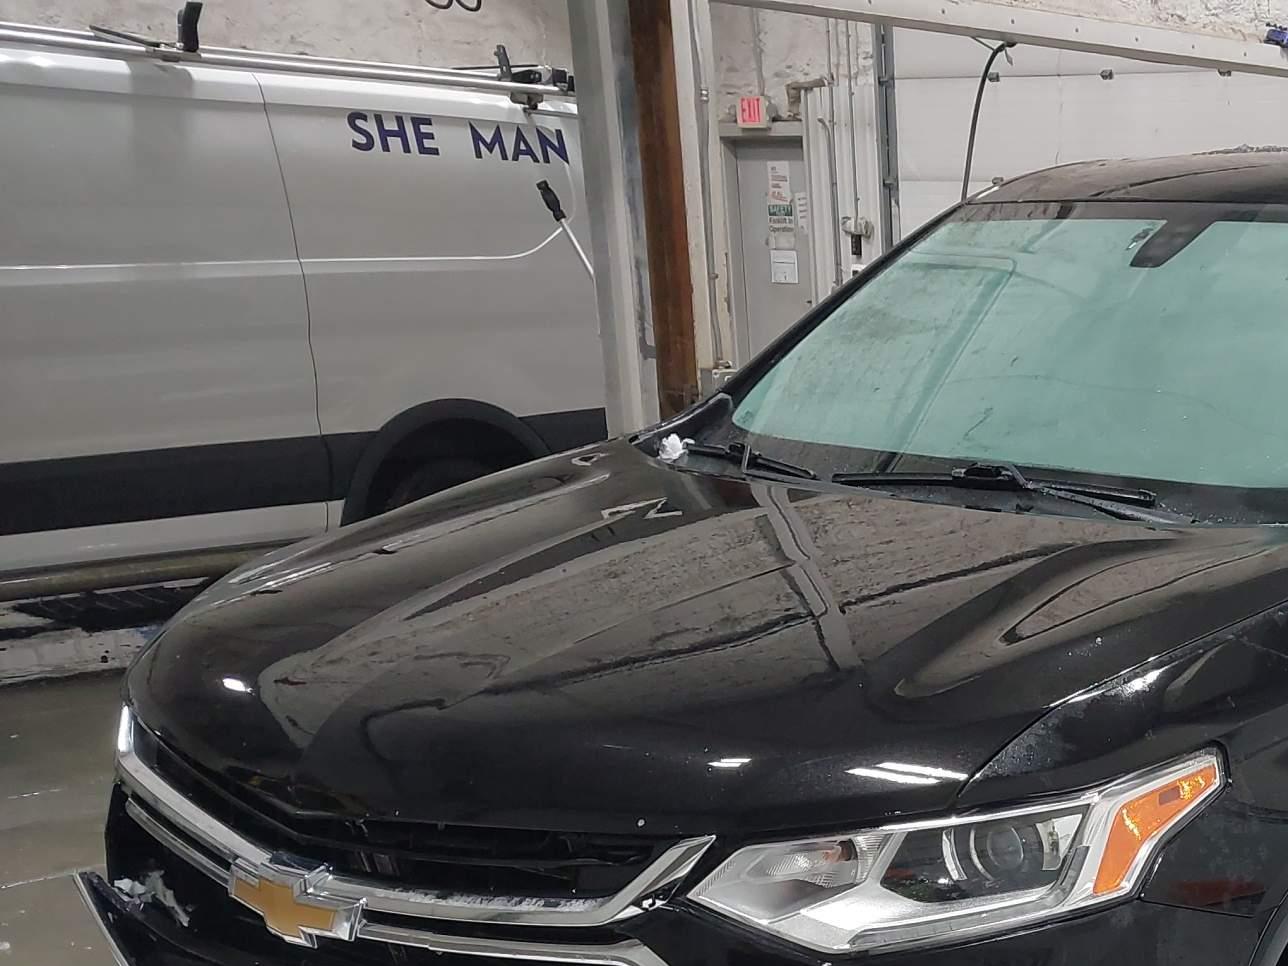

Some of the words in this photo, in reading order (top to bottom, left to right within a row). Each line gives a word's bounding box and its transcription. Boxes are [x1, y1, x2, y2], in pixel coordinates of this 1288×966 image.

[741, 97, 760, 123] EXIT
[347, 111, 440, 156] SHE
[468, 120, 570, 165] MAN
